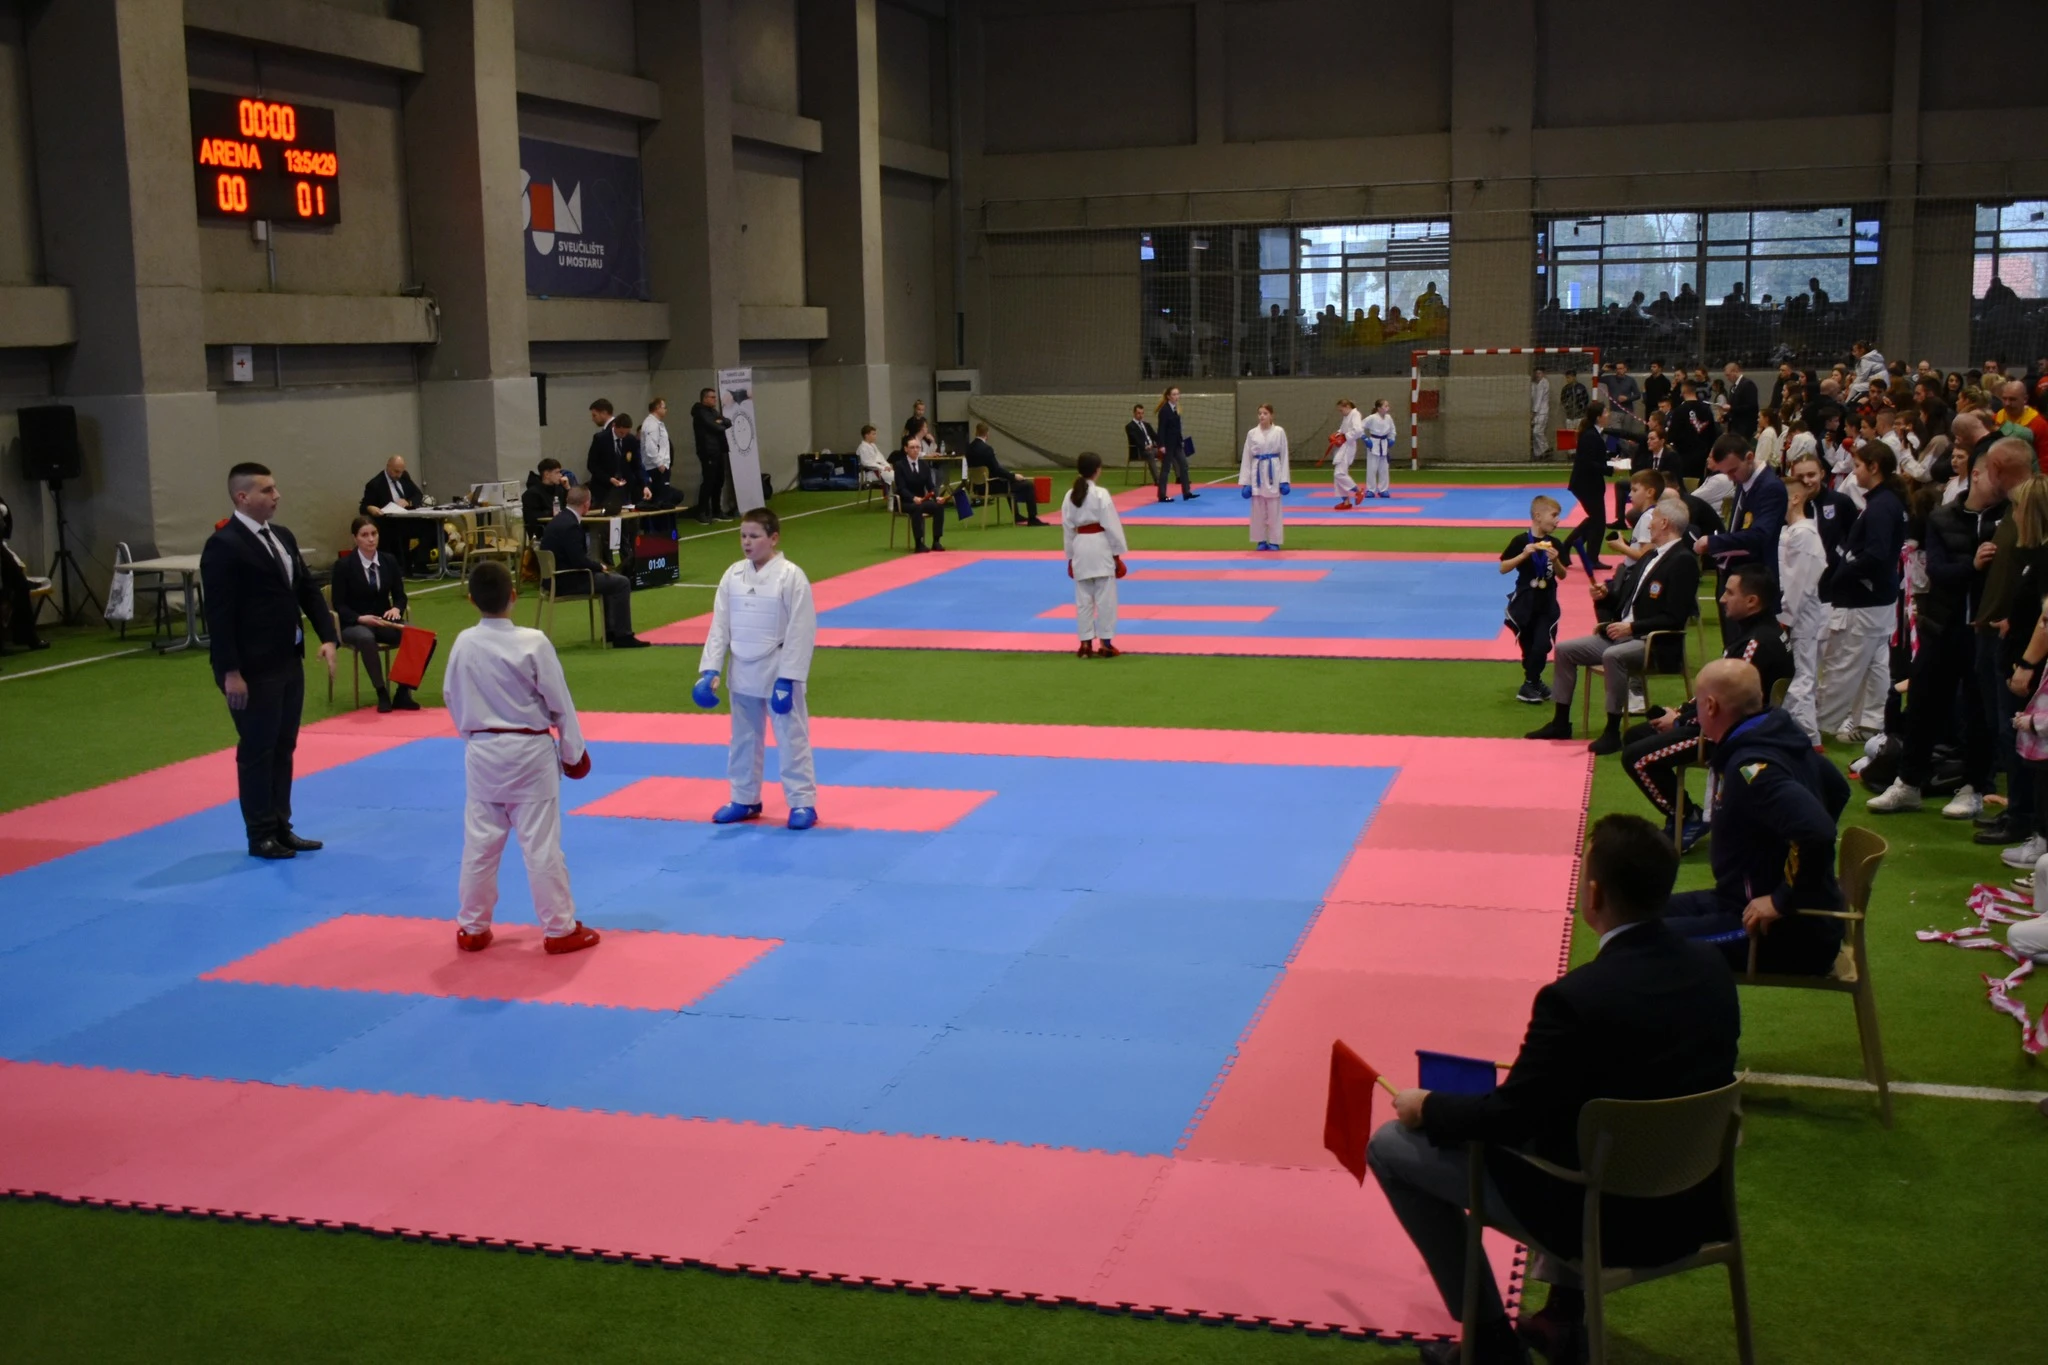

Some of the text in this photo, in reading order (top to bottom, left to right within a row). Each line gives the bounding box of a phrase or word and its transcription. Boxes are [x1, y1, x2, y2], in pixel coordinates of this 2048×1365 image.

[239, 100, 296, 142] 00:00
[200, 138, 262, 170] ARENA
[217, 174, 248, 212] 00
[558, 240, 605, 256] SVEUČILIŠTE
[558, 255, 603, 269] U MOSTARU
[648, 557, 666, 571] 01:00
